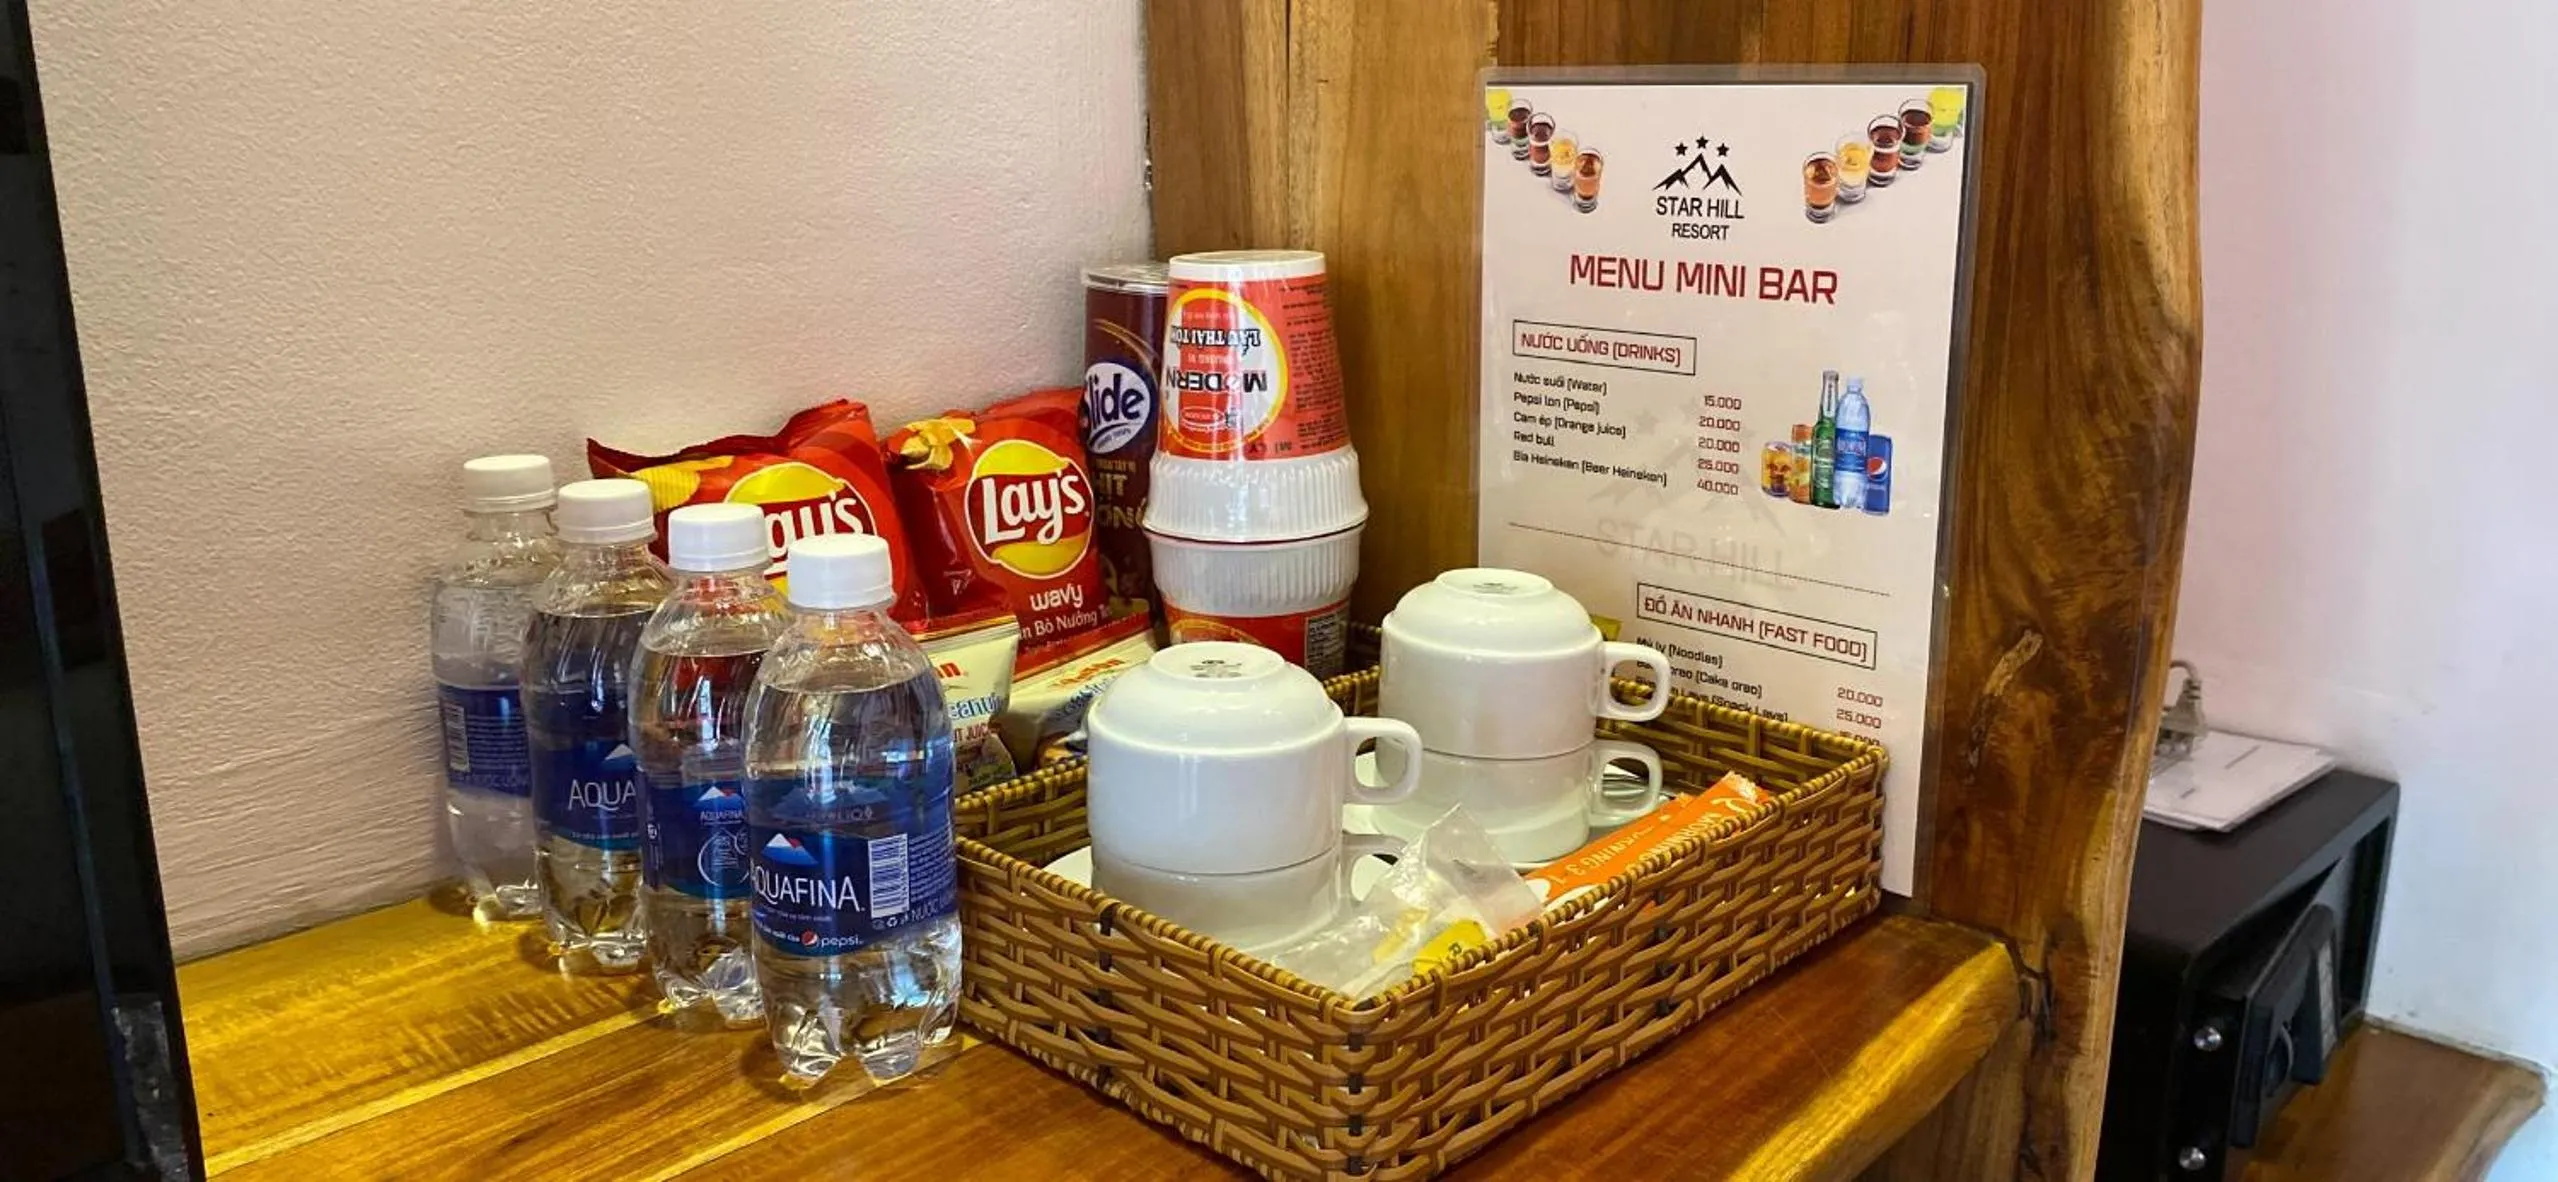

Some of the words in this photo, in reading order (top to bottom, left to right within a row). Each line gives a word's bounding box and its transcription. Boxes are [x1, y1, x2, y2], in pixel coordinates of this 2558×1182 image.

[1656, 195, 1702, 218] STAR
[1706, 198, 1745, 219] HILL
[1671, 222, 1730, 240] RESORT
[1570, 254, 1665, 291] MENU
[1676, 260, 1747, 298] MINI
[1758, 266, 1838, 305] BAR
[1703, 394, 1742, 410] 15.000
[1513, 411, 1537, 425] Cam
[1699, 415, 1741, 431] 20.000
[1513, 430, 1534, 443] Red
[1535, 433, 1555, 446] bull
[1698, 436, 1741, 453] 20.000
[1513, 450, 1529, 463] Bia
[1696, 478, 1739, 495] 40.000
[981, 470, 1085, 545] Lay's
[1030, 583, 1084, 612] wavy
[1697, 607, 1754, 634] NHANH
[1837, 687, 1883, 708] 20.000
[1836, 708, 1882, 729] 25.000
[821, 933, 859, 949] pepsi
